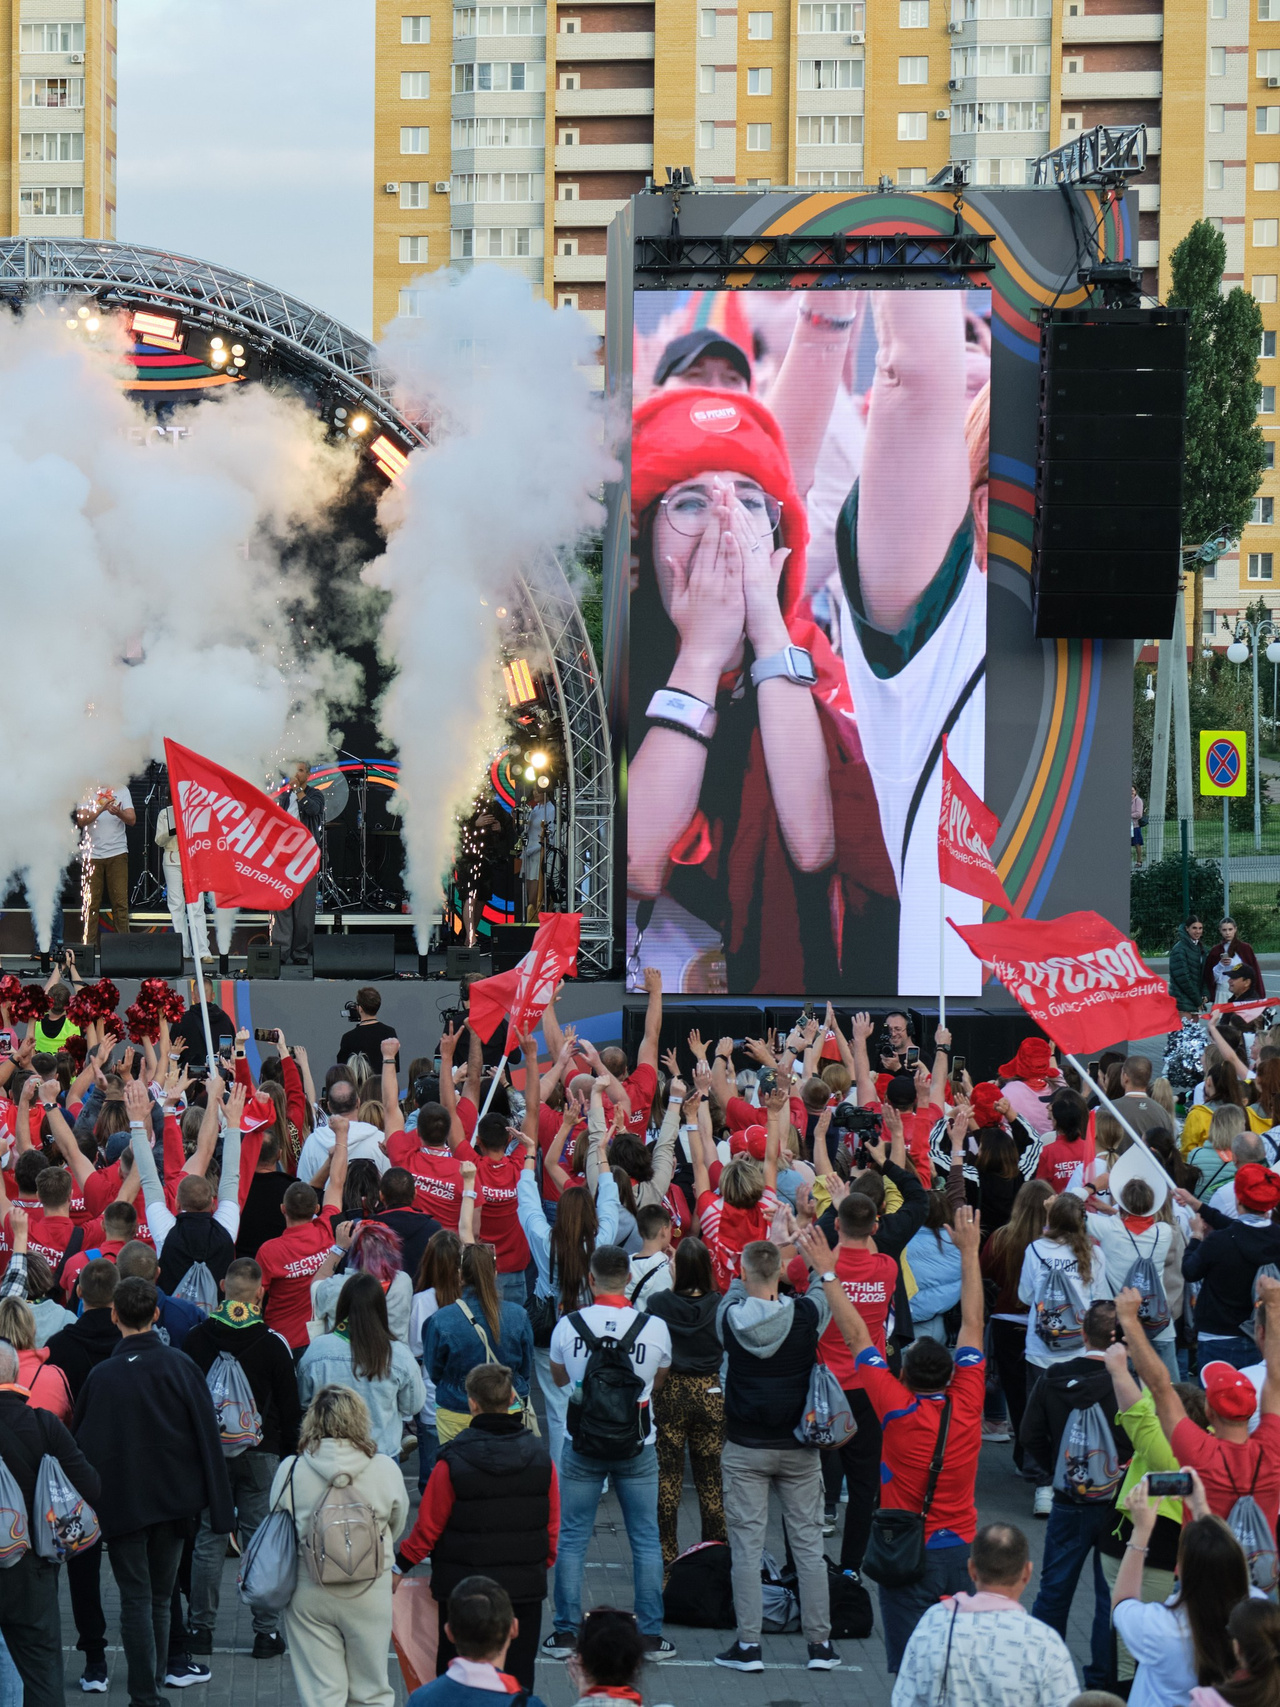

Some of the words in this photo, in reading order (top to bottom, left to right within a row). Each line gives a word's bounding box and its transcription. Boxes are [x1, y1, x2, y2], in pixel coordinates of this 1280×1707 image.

[1054, 1161, 1081, 1170] ЧЕСТ
[430, 1184, 455, 1201] 2025
[27, 1241, 64, 1259] ЧЕСТН
[283, 1248, 330, 1273] ЧЕСТНЫ
[859, 1292, 887, 1303] 2025
